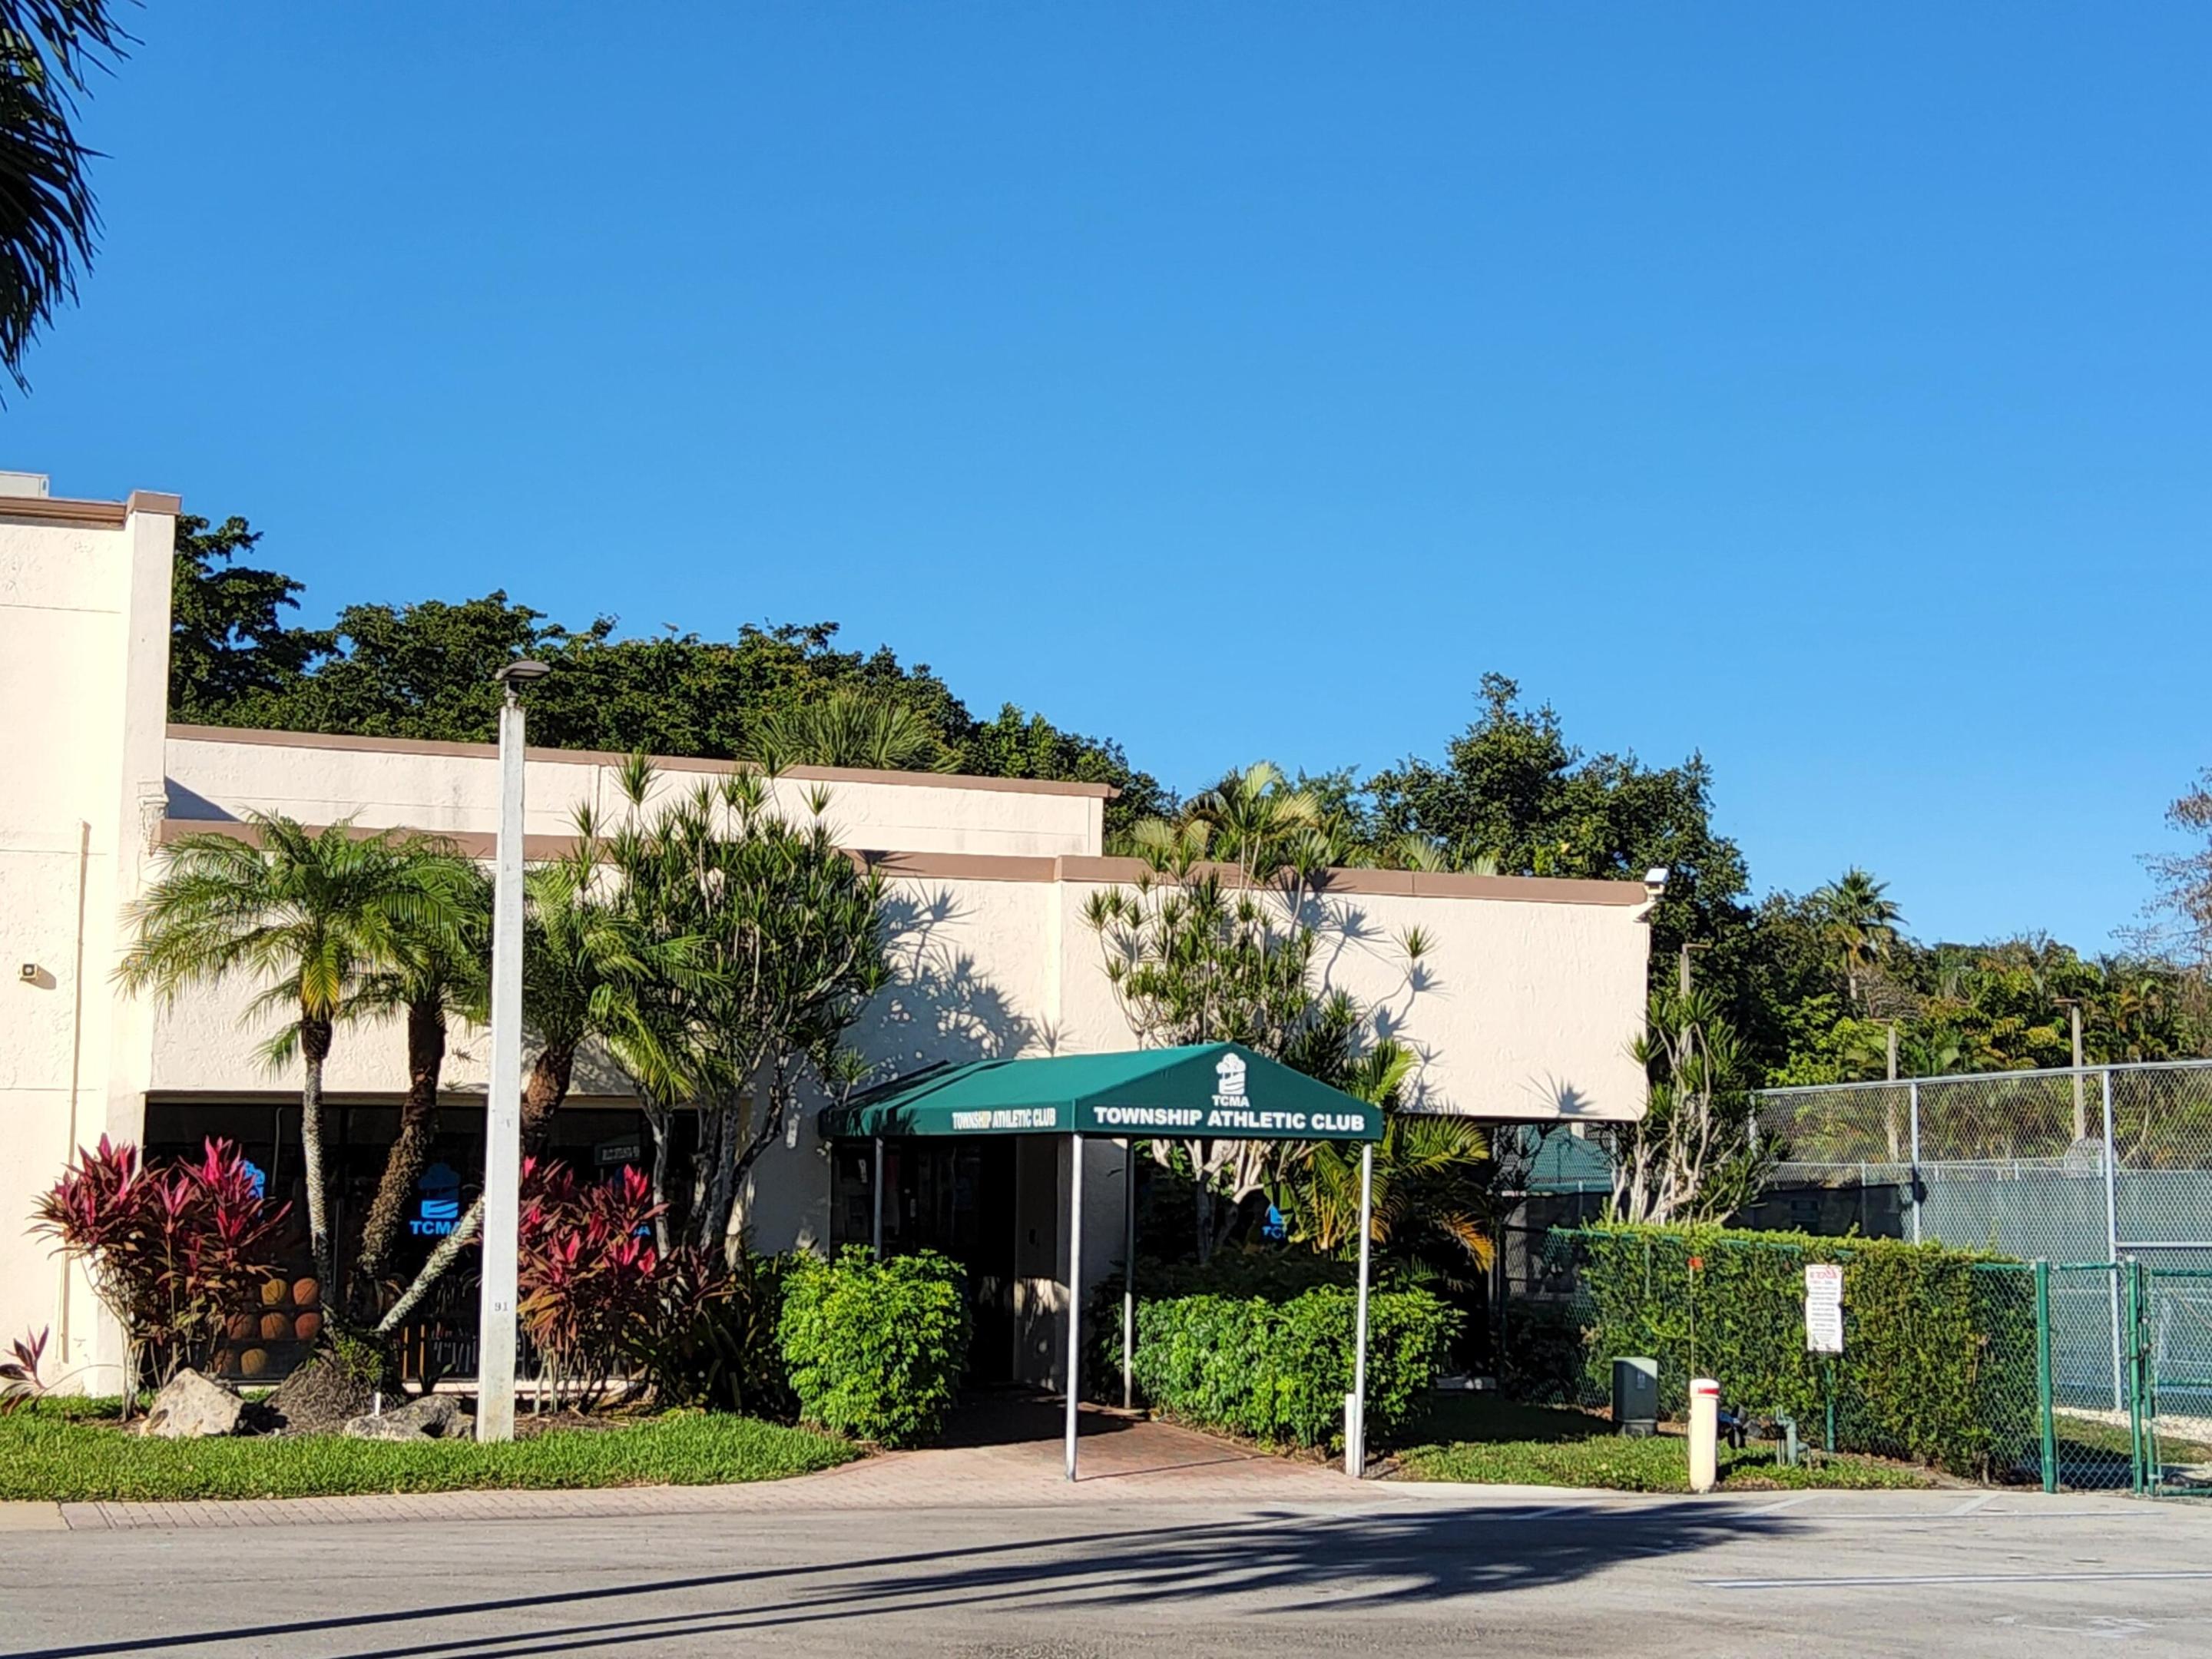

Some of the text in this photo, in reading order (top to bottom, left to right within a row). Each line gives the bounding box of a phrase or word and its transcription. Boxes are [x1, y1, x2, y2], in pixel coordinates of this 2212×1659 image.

[1212, 1095, 1250, 1108] TCMA
[952, 1108, 1056, 1130] TOWNSHIP ATHLETIC CLUB
[1093, 1106, 1365, 1131] TOWNSHIP ATHLETIC CLUB
